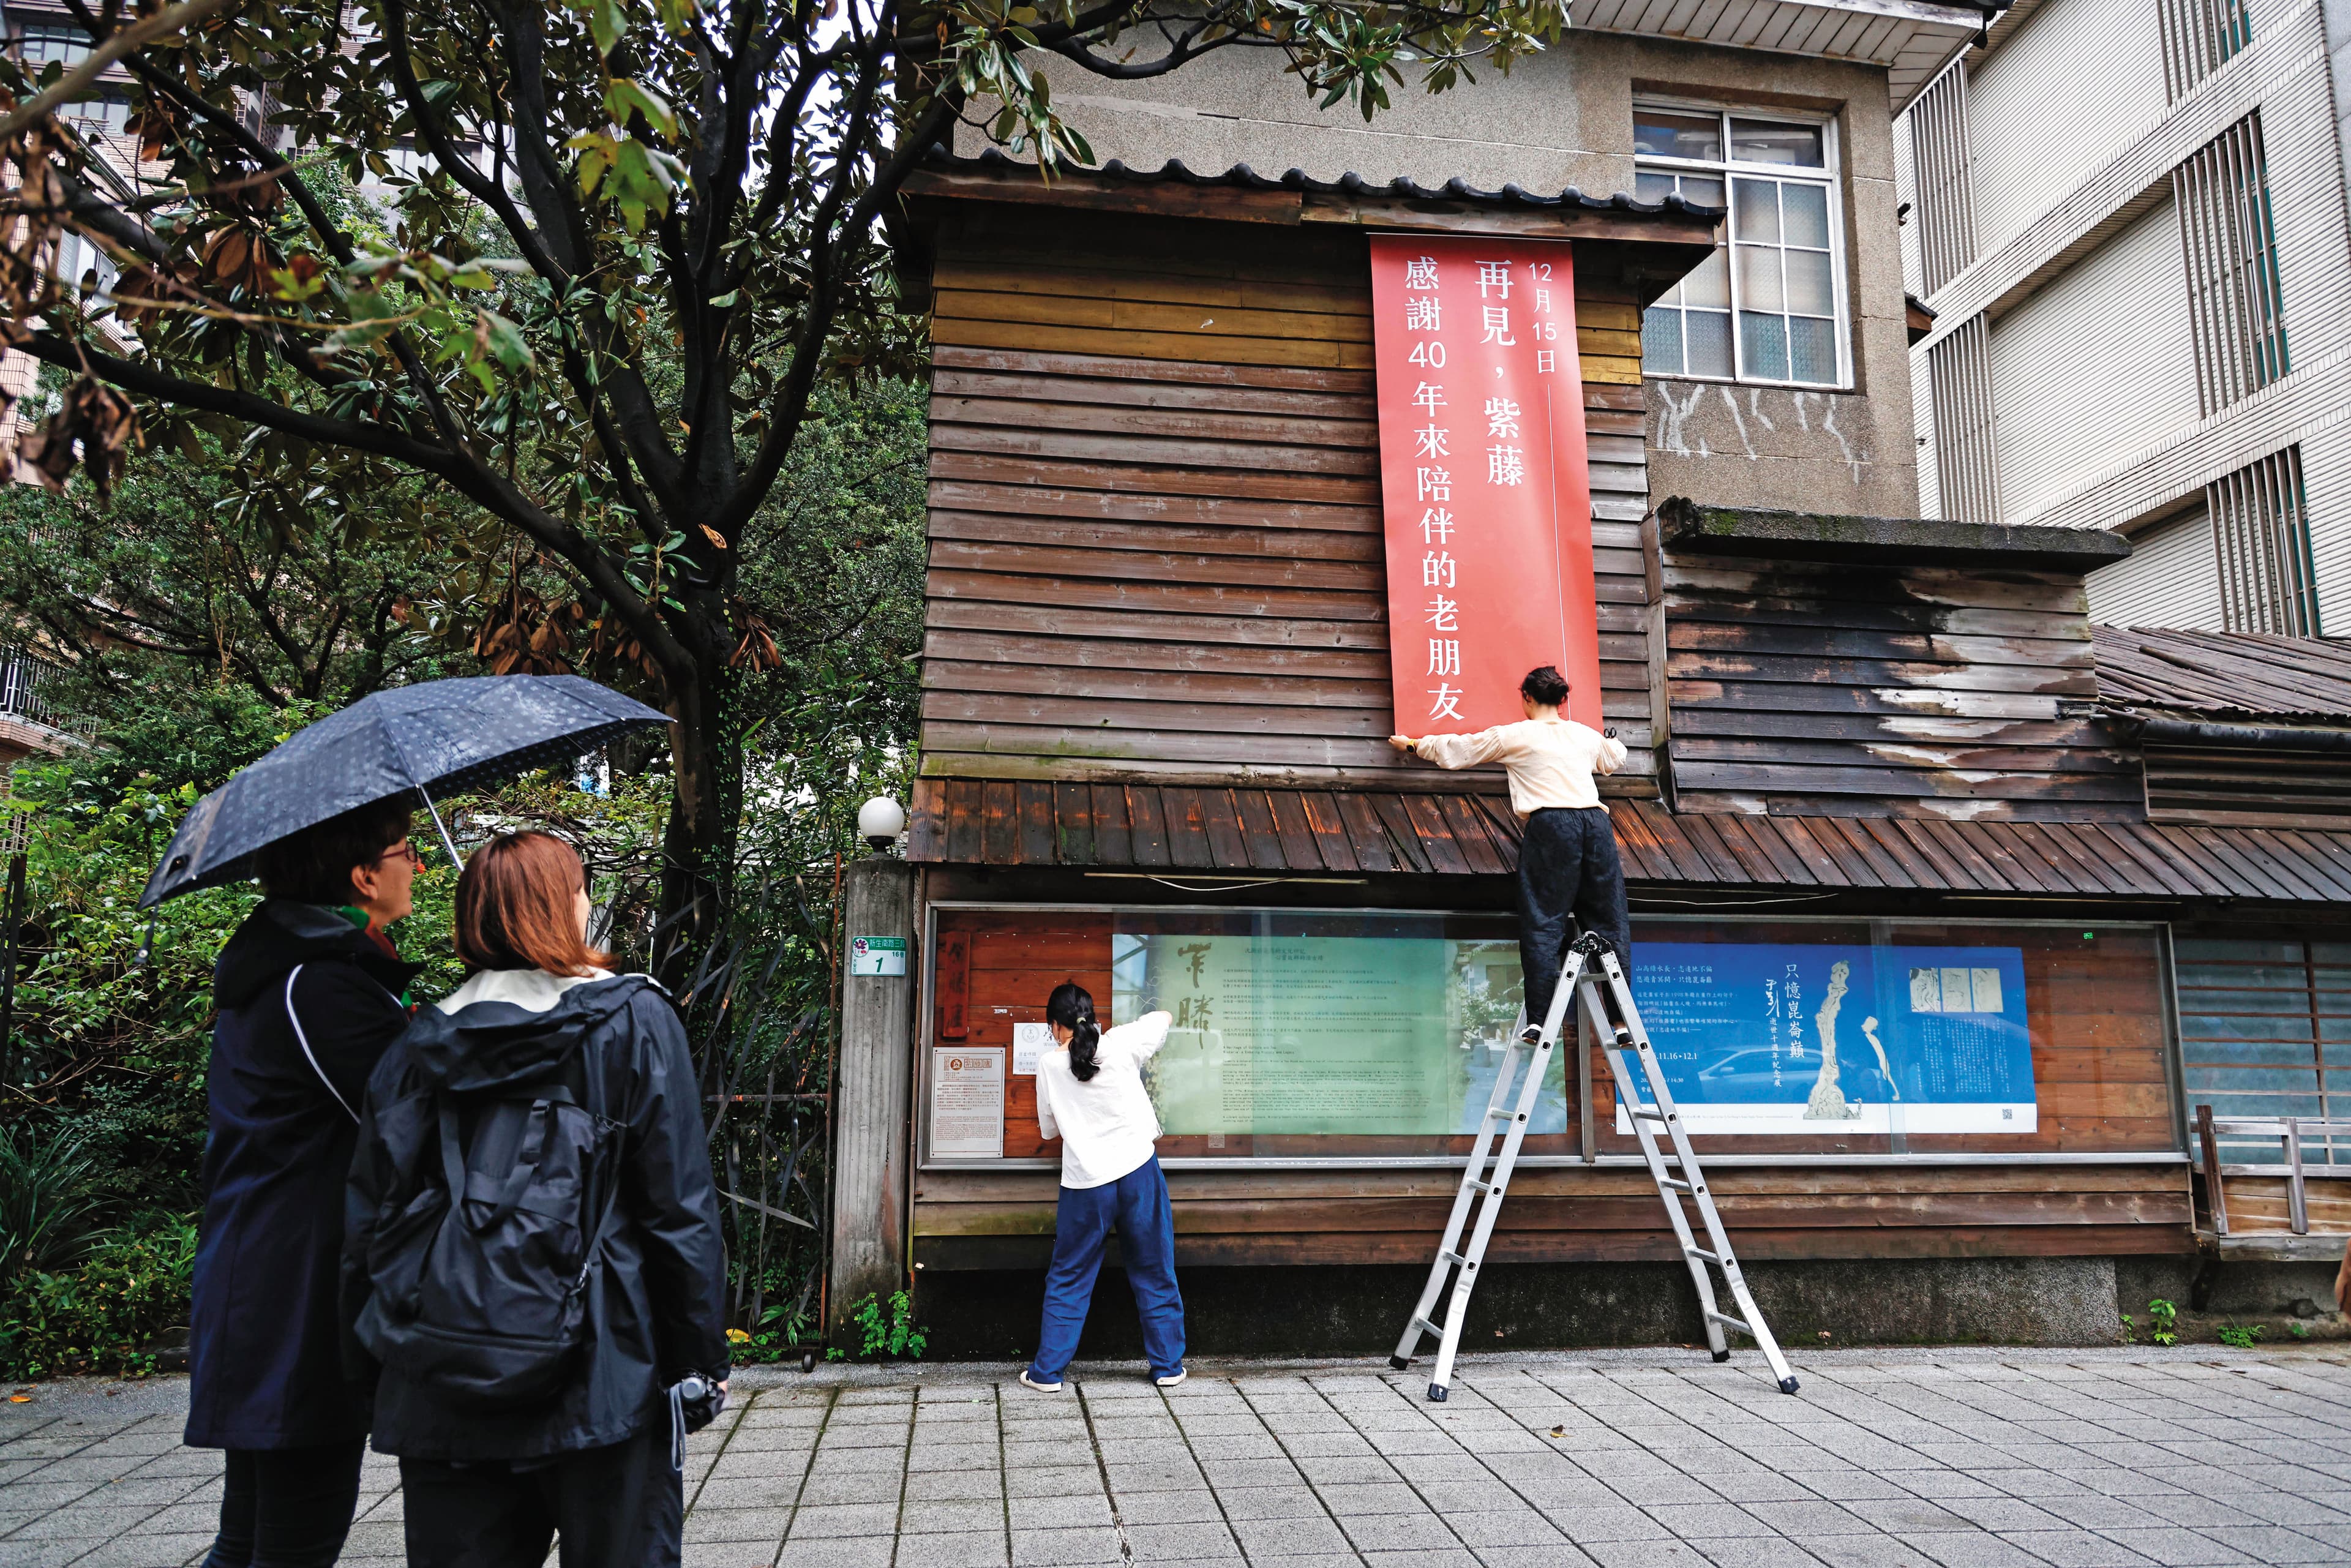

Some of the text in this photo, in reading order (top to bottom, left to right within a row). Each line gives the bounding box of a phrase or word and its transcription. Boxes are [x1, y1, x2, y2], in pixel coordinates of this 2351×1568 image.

[1474, 259, 1526, 487] 再見，紫藤
[1528, 262, 1558, 374] 12月15日
[1404, 256, 1465, 721] 感謝40年來陪伴的老朋友
[875, 957, 883, 973] 1
